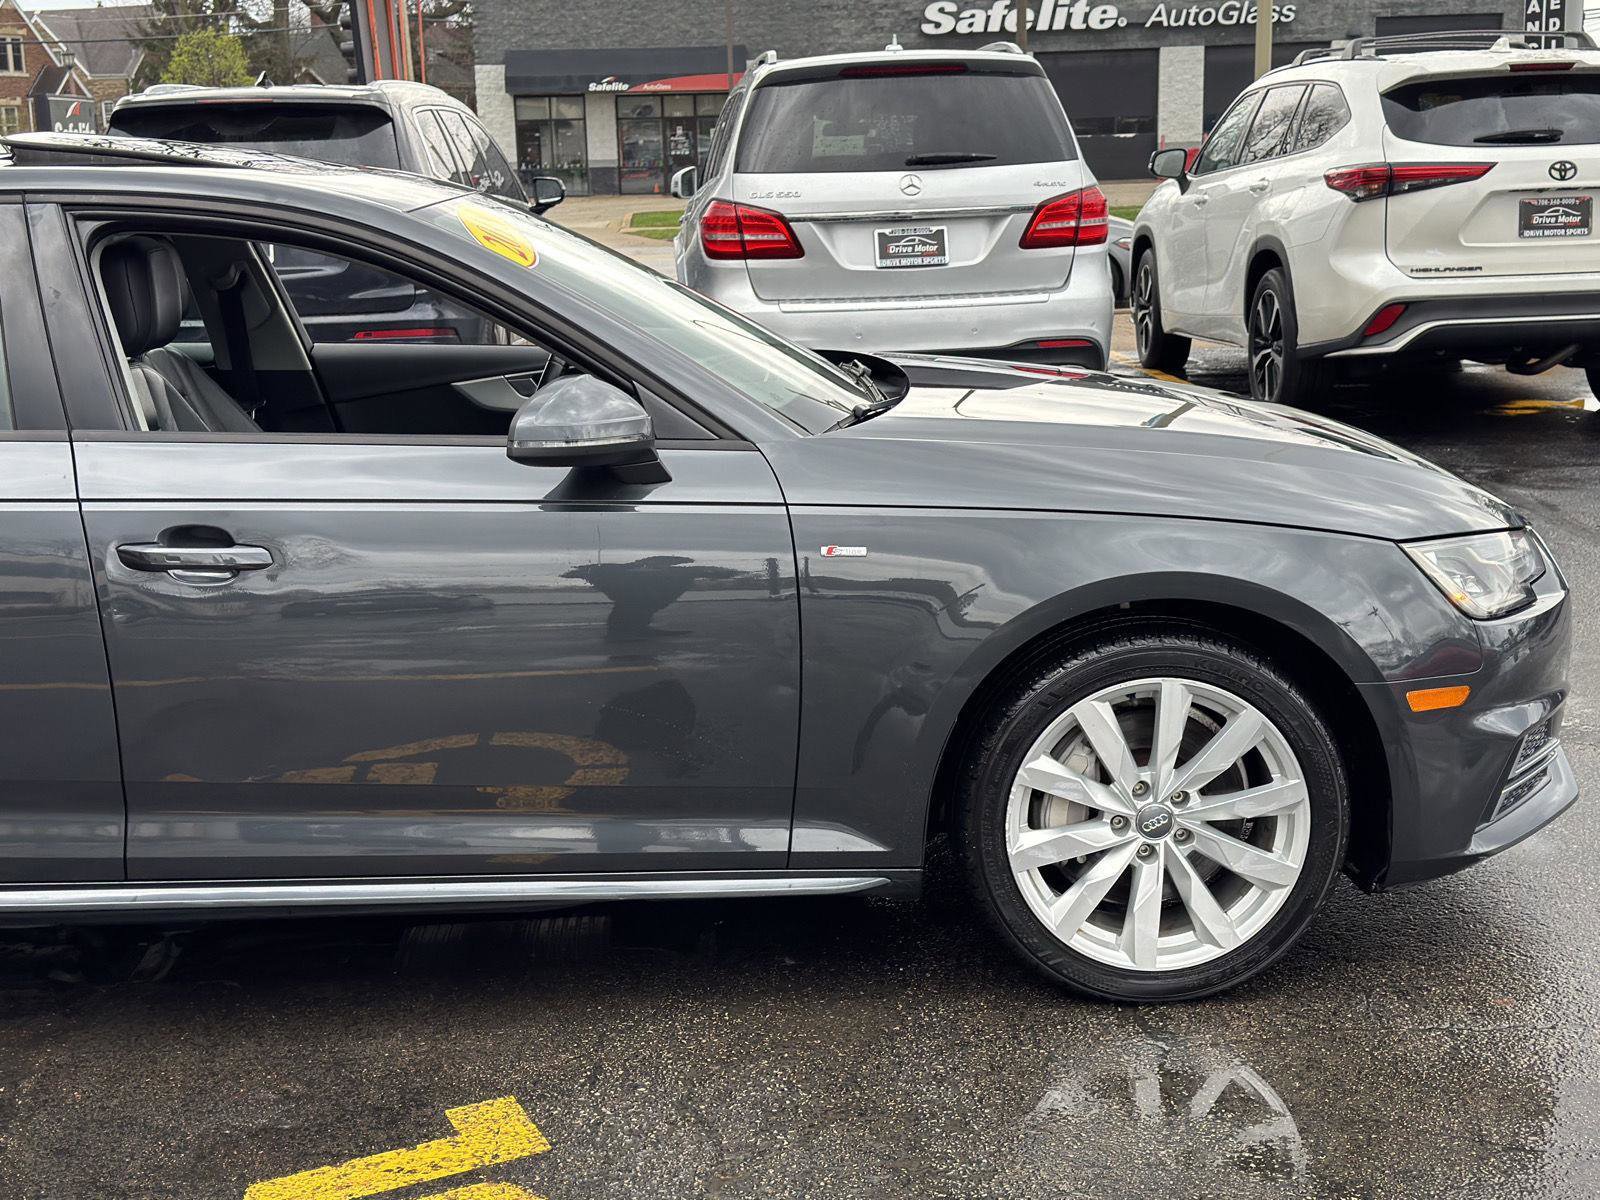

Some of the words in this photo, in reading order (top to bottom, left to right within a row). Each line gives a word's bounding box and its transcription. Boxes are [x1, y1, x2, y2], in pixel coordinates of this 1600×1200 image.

[921, 0, 1119, 34] Safelite
[588, 82, 630, 92] Safelite
[1557, 215, 1582, 223] Motor
[1544, 228, 1566, 236] MOTOR
[1566, 227, 1589, 235] SPORTS
[914, 243, 939, 253] Motor
